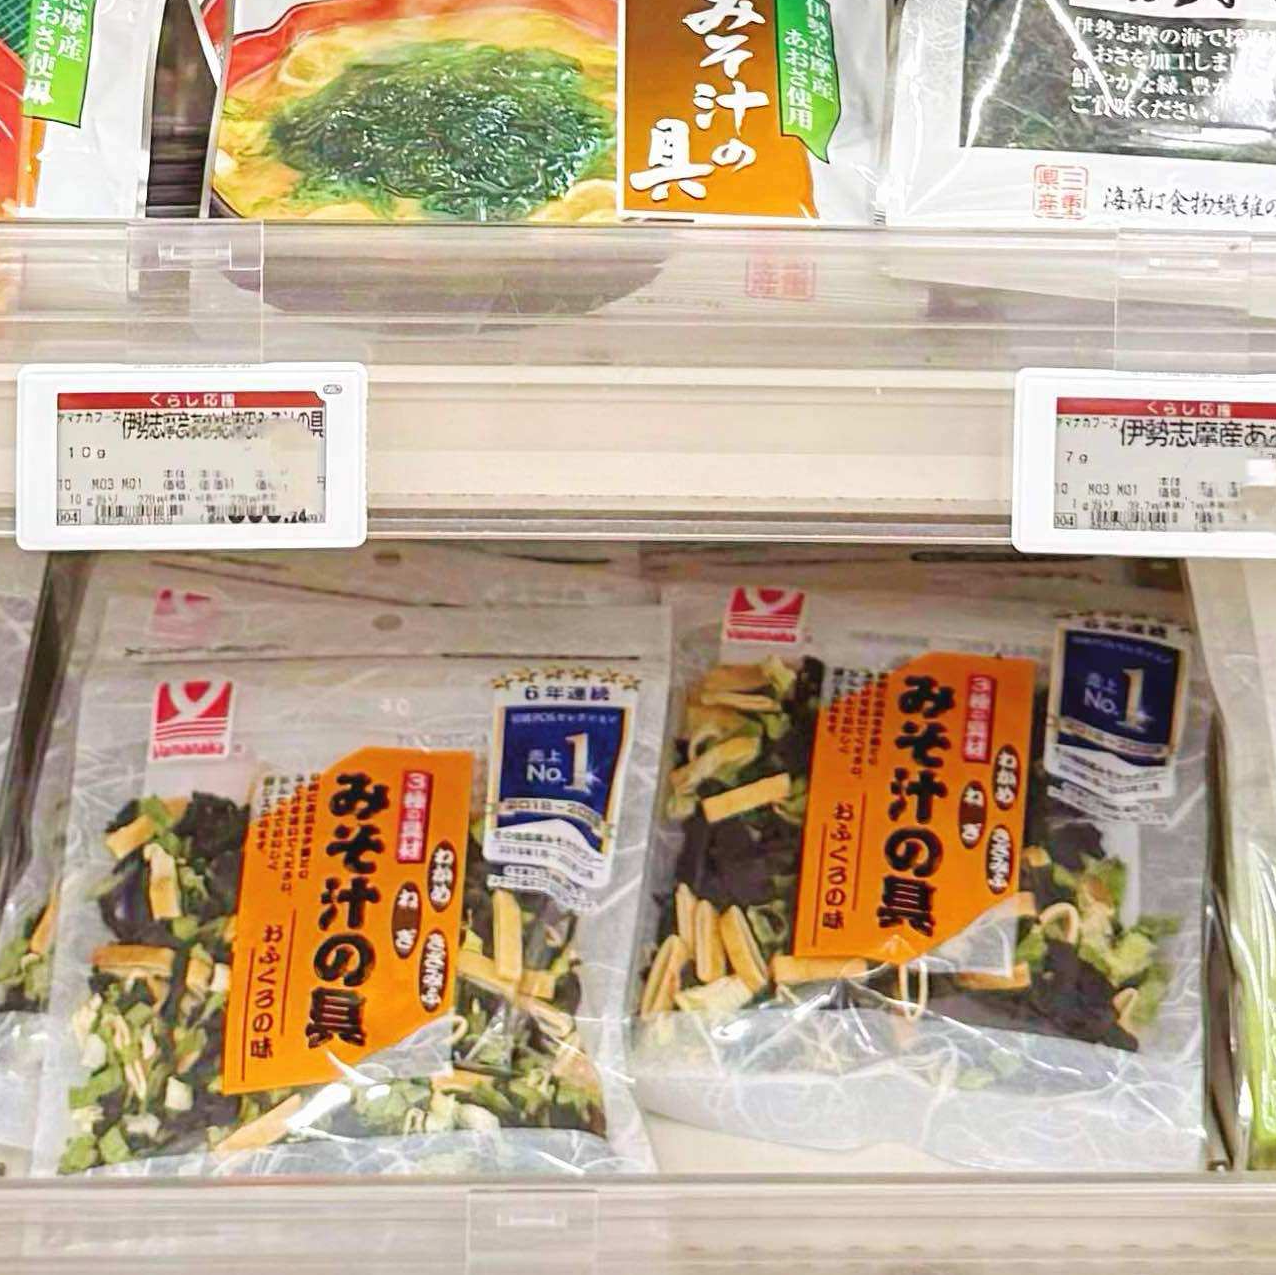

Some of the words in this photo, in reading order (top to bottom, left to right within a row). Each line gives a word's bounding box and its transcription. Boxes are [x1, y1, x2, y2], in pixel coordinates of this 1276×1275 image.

[782, 27, 817, 131] あおさ使用
[525, 686, 610, 701] 6年連続
[877, 676, 956, 937] みそ汁の具
[305, 772, 390, 1049] みそ汁の具
[250, 924, 283, 1059] おふくろの味
